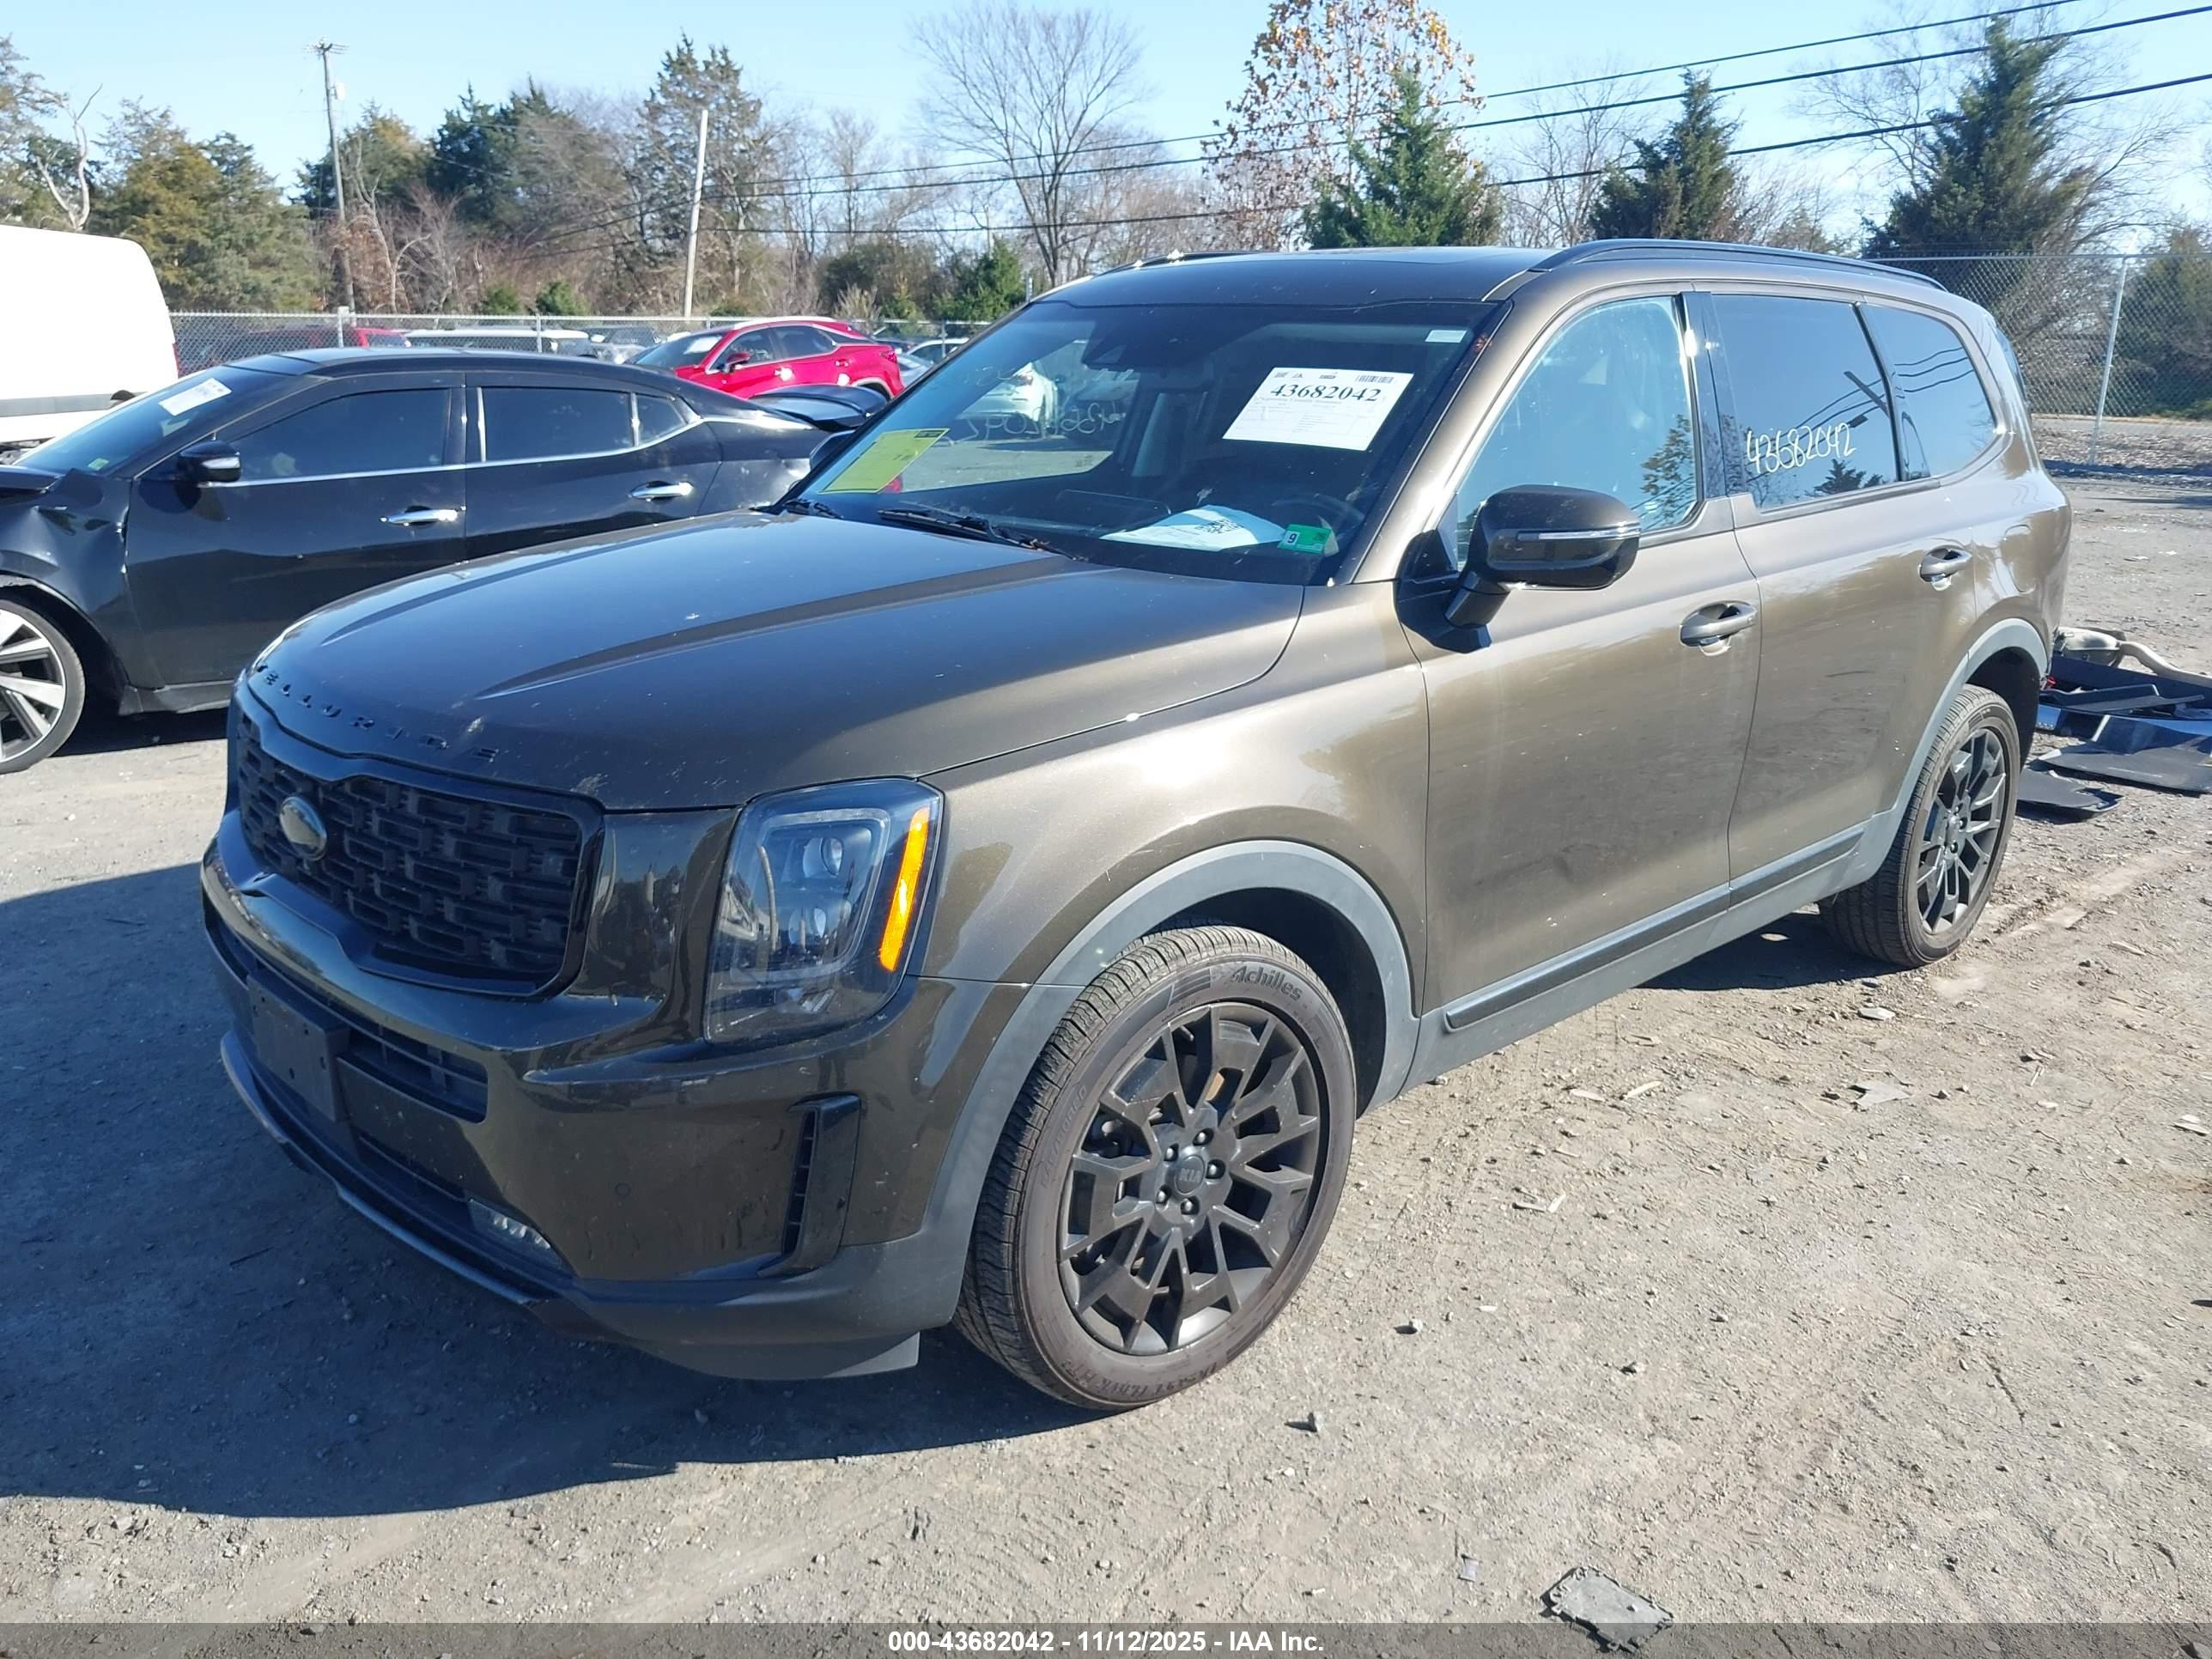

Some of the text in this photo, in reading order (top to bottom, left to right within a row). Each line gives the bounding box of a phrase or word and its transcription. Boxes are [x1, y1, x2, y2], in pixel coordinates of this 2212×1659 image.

[1270, 383, 1382, 402] 43682042
[1746, 422, 1857, 474] 43682042
[1230, 965, 1303, 1001] Achilles
